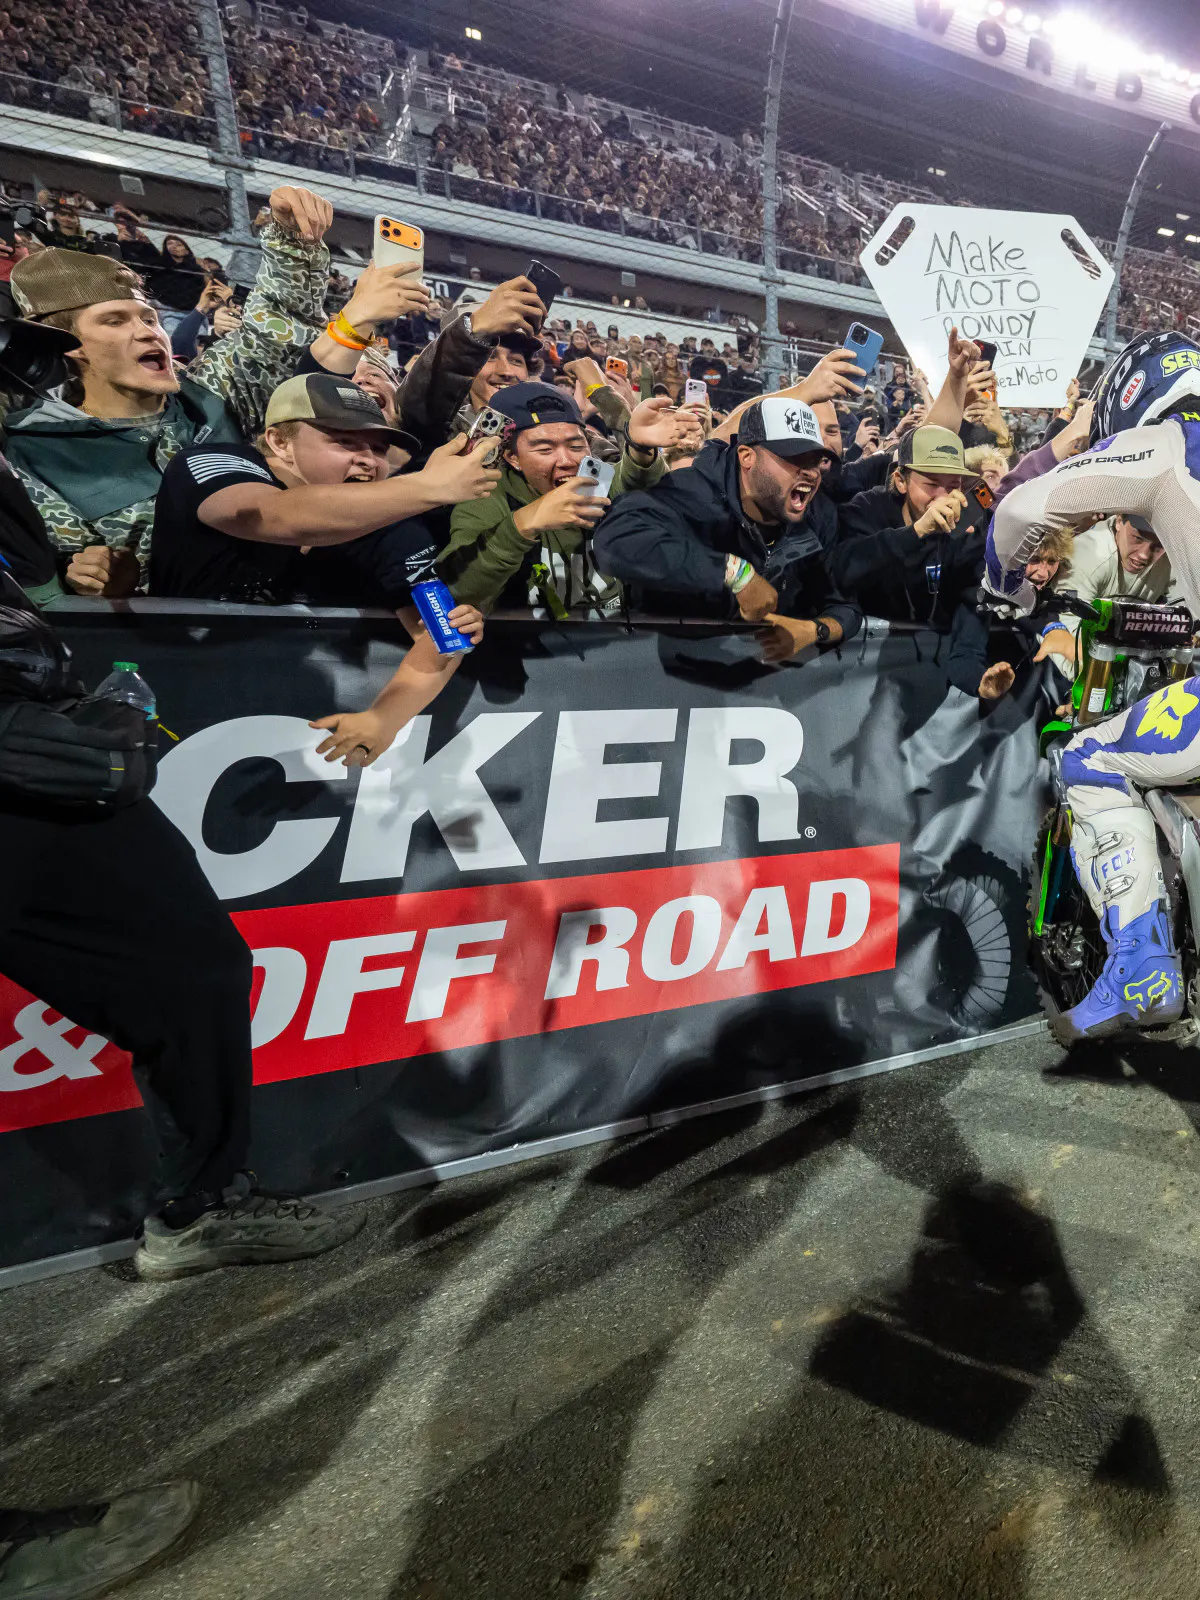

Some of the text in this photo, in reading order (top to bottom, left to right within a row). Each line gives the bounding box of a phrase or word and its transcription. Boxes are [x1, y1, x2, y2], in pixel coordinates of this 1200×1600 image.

[915, 0, 1143, 102] WORLD
[926, 230, 1028, 275] Make
[935, 273, 1041, 312] MOTO
[995, 340, 1031, 358] AIN
[1122, 377, 1143, 405] BELL
[1056, 449, 1155, 473] PRO CIRCUIT
[425, 591, 453, 637] BUD LIGHT
[1124, 622, 1189, 634] RENTHAL
[1126, 611, 1189, 623] RENTHAL
[150, 706, 803, 900] CKER
[1102, 847, 1136, 879] FOX
[543, 877, 871, 1001] ROAD
